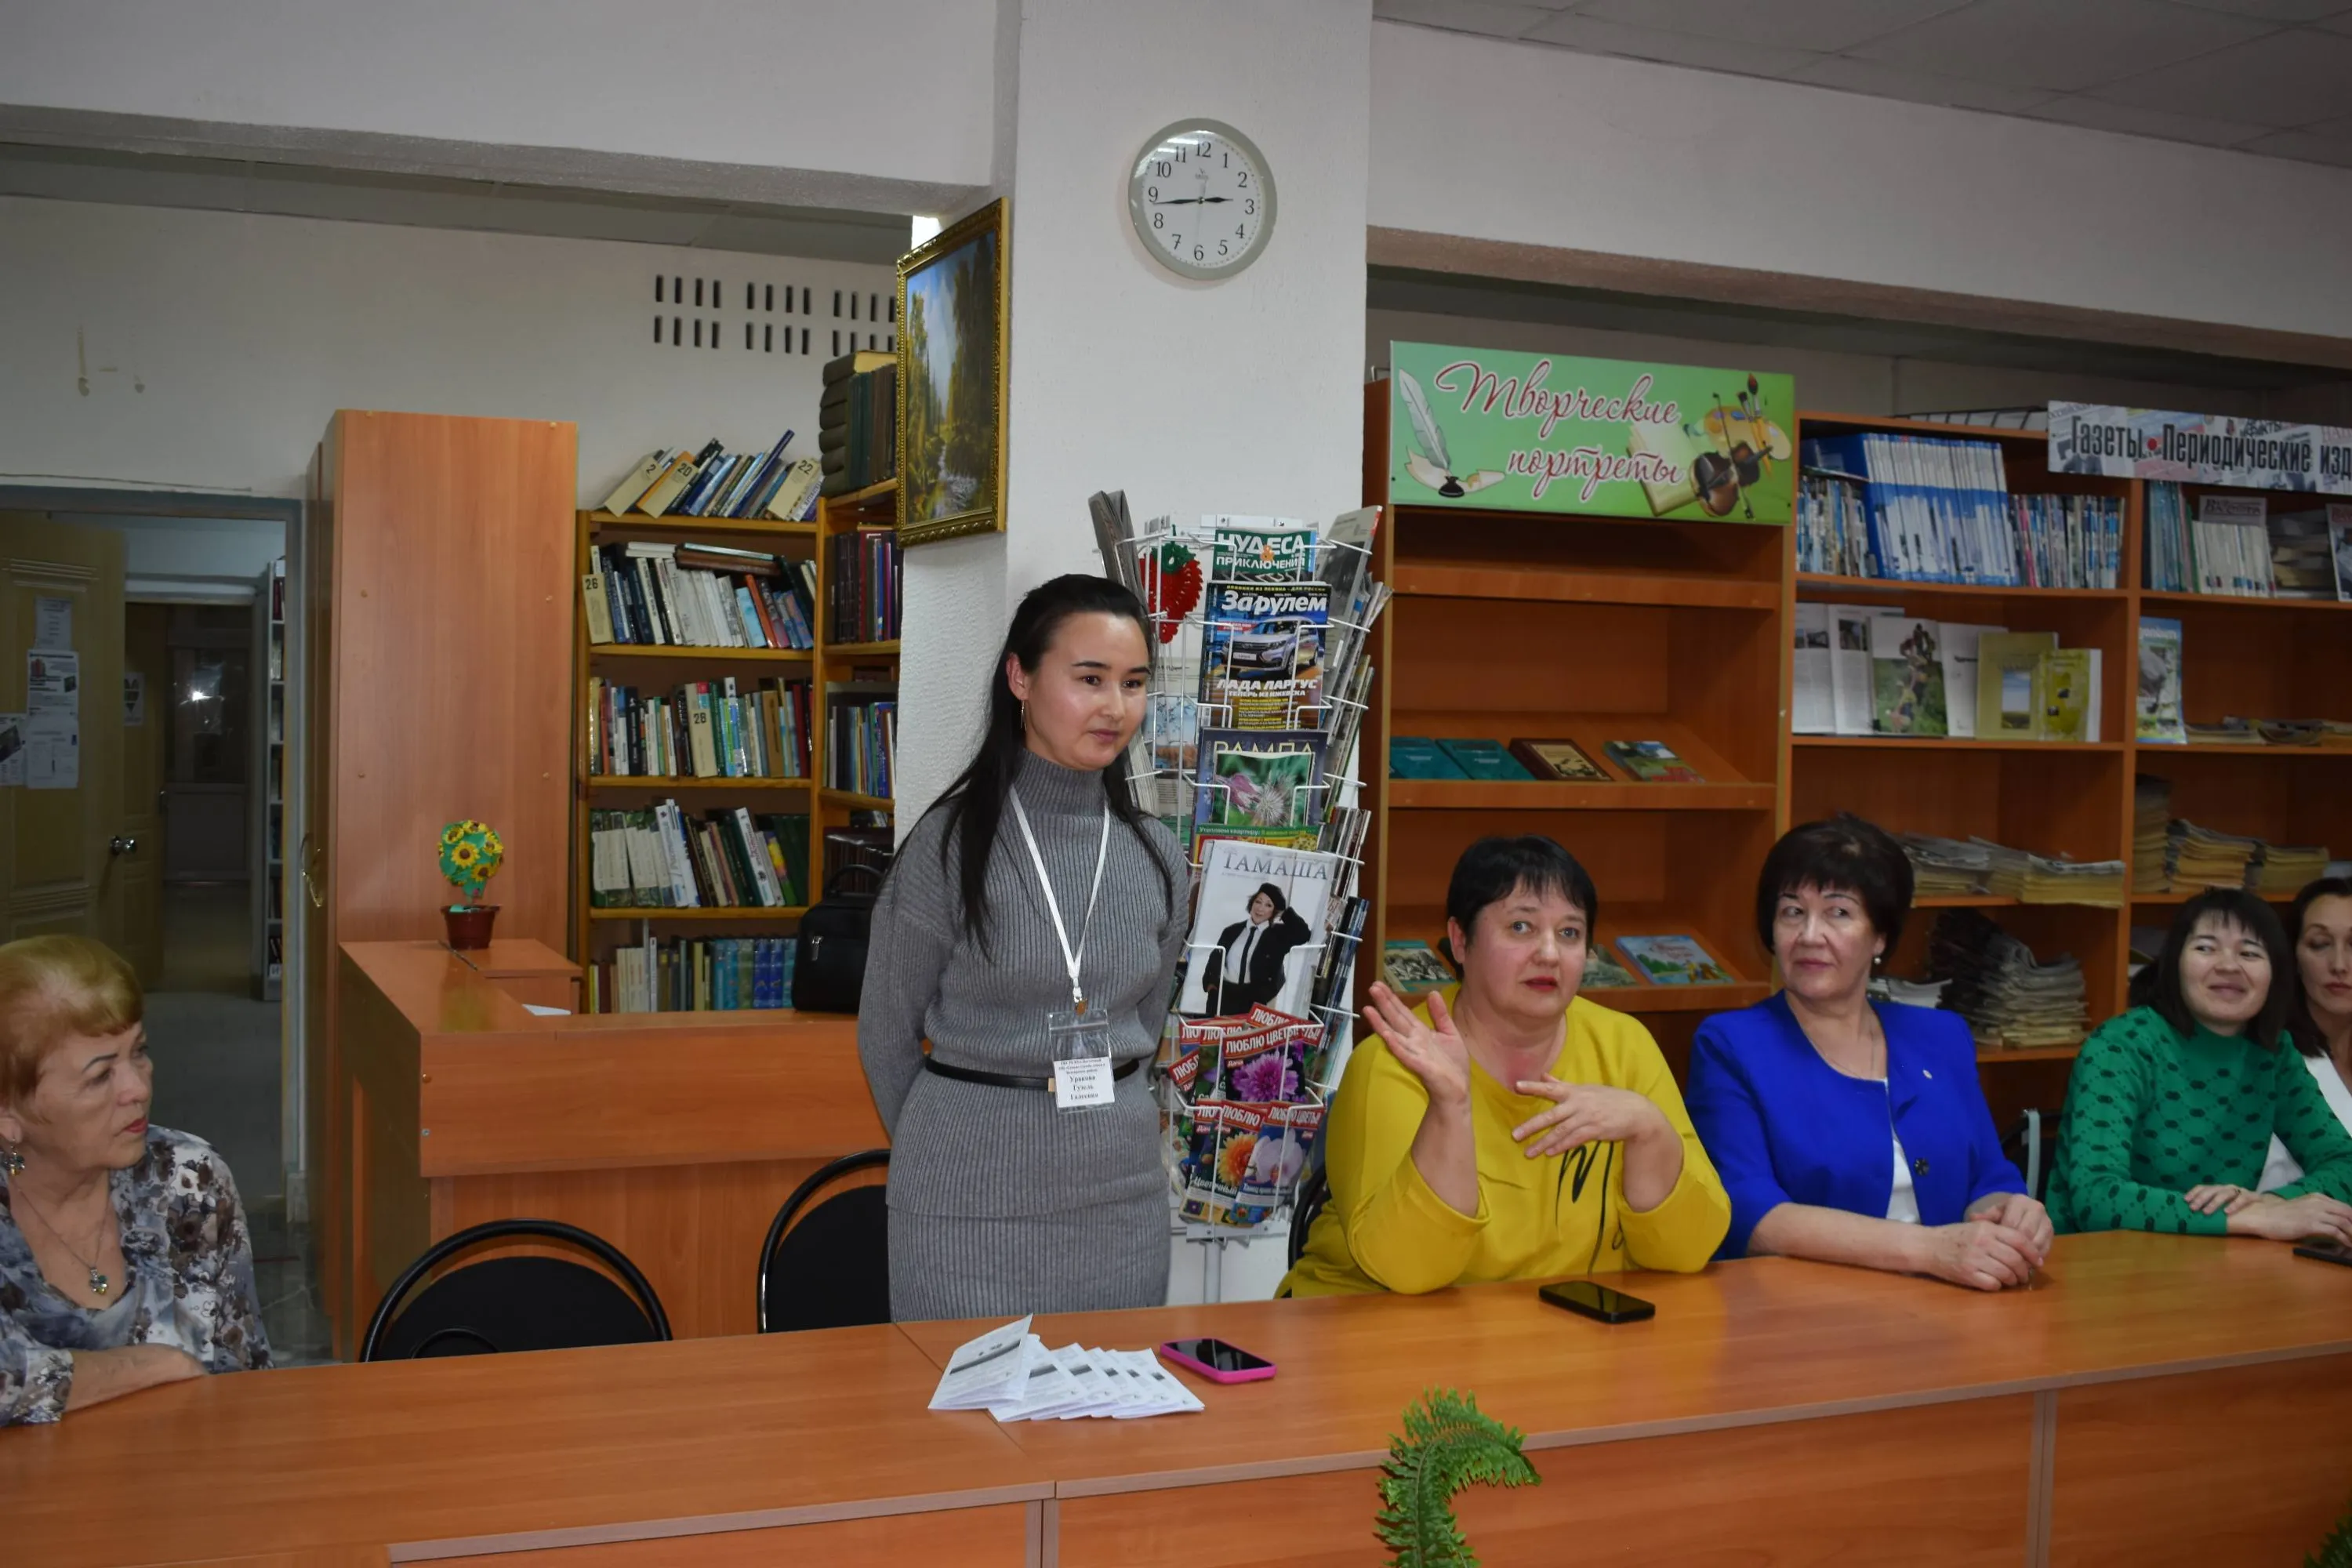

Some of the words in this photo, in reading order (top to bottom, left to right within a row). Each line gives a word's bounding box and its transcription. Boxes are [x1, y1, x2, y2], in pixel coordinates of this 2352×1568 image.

[1175, 147, 1186, 163] 11
[1195, 141, 1212, 158] 12
[1222, 152, 1229, 169] 1
[1156, 162, 1172, 178] 10
[1237, 172, 1248, 188] 2
[1148, 187, 1159, 203] 9
[1245, 198, 1254, 215] 3
[1153, 212, 1164, 230] 8
[1235, 223, 1245, 239] 4
[1171, 234, 1181, 250] 7
[1218, 239, 1229, 256] 5
[1193, 245, 1205, 261] 6
[1435, 359, 1682, 441] Творческие
[2071, 415, 2143, 459] Газеты
[2161, 423, 2311, 474] Периодические
[645, 463, 657, 474] 2
[677, 463, 693, 477] 20
[798, 459, 814, 474] 22
[1508, 447, 1685, 503] портреты
[1218, 533, 1305, 556] ЧУДЕСА
[1216, 679, 1262, 691] ЛАДА
[1263, 679, 1319, 691] ЛАРГУС
[1223, 851, 1328, 880] ТАМАША
[1225, 1033, 1265, 1054] ЛЮБЛЮ
[1222, 1104, 1261, 1127] ЛЮБЛЮ
[1194, 1176, 1238, 1195] Цветчный
